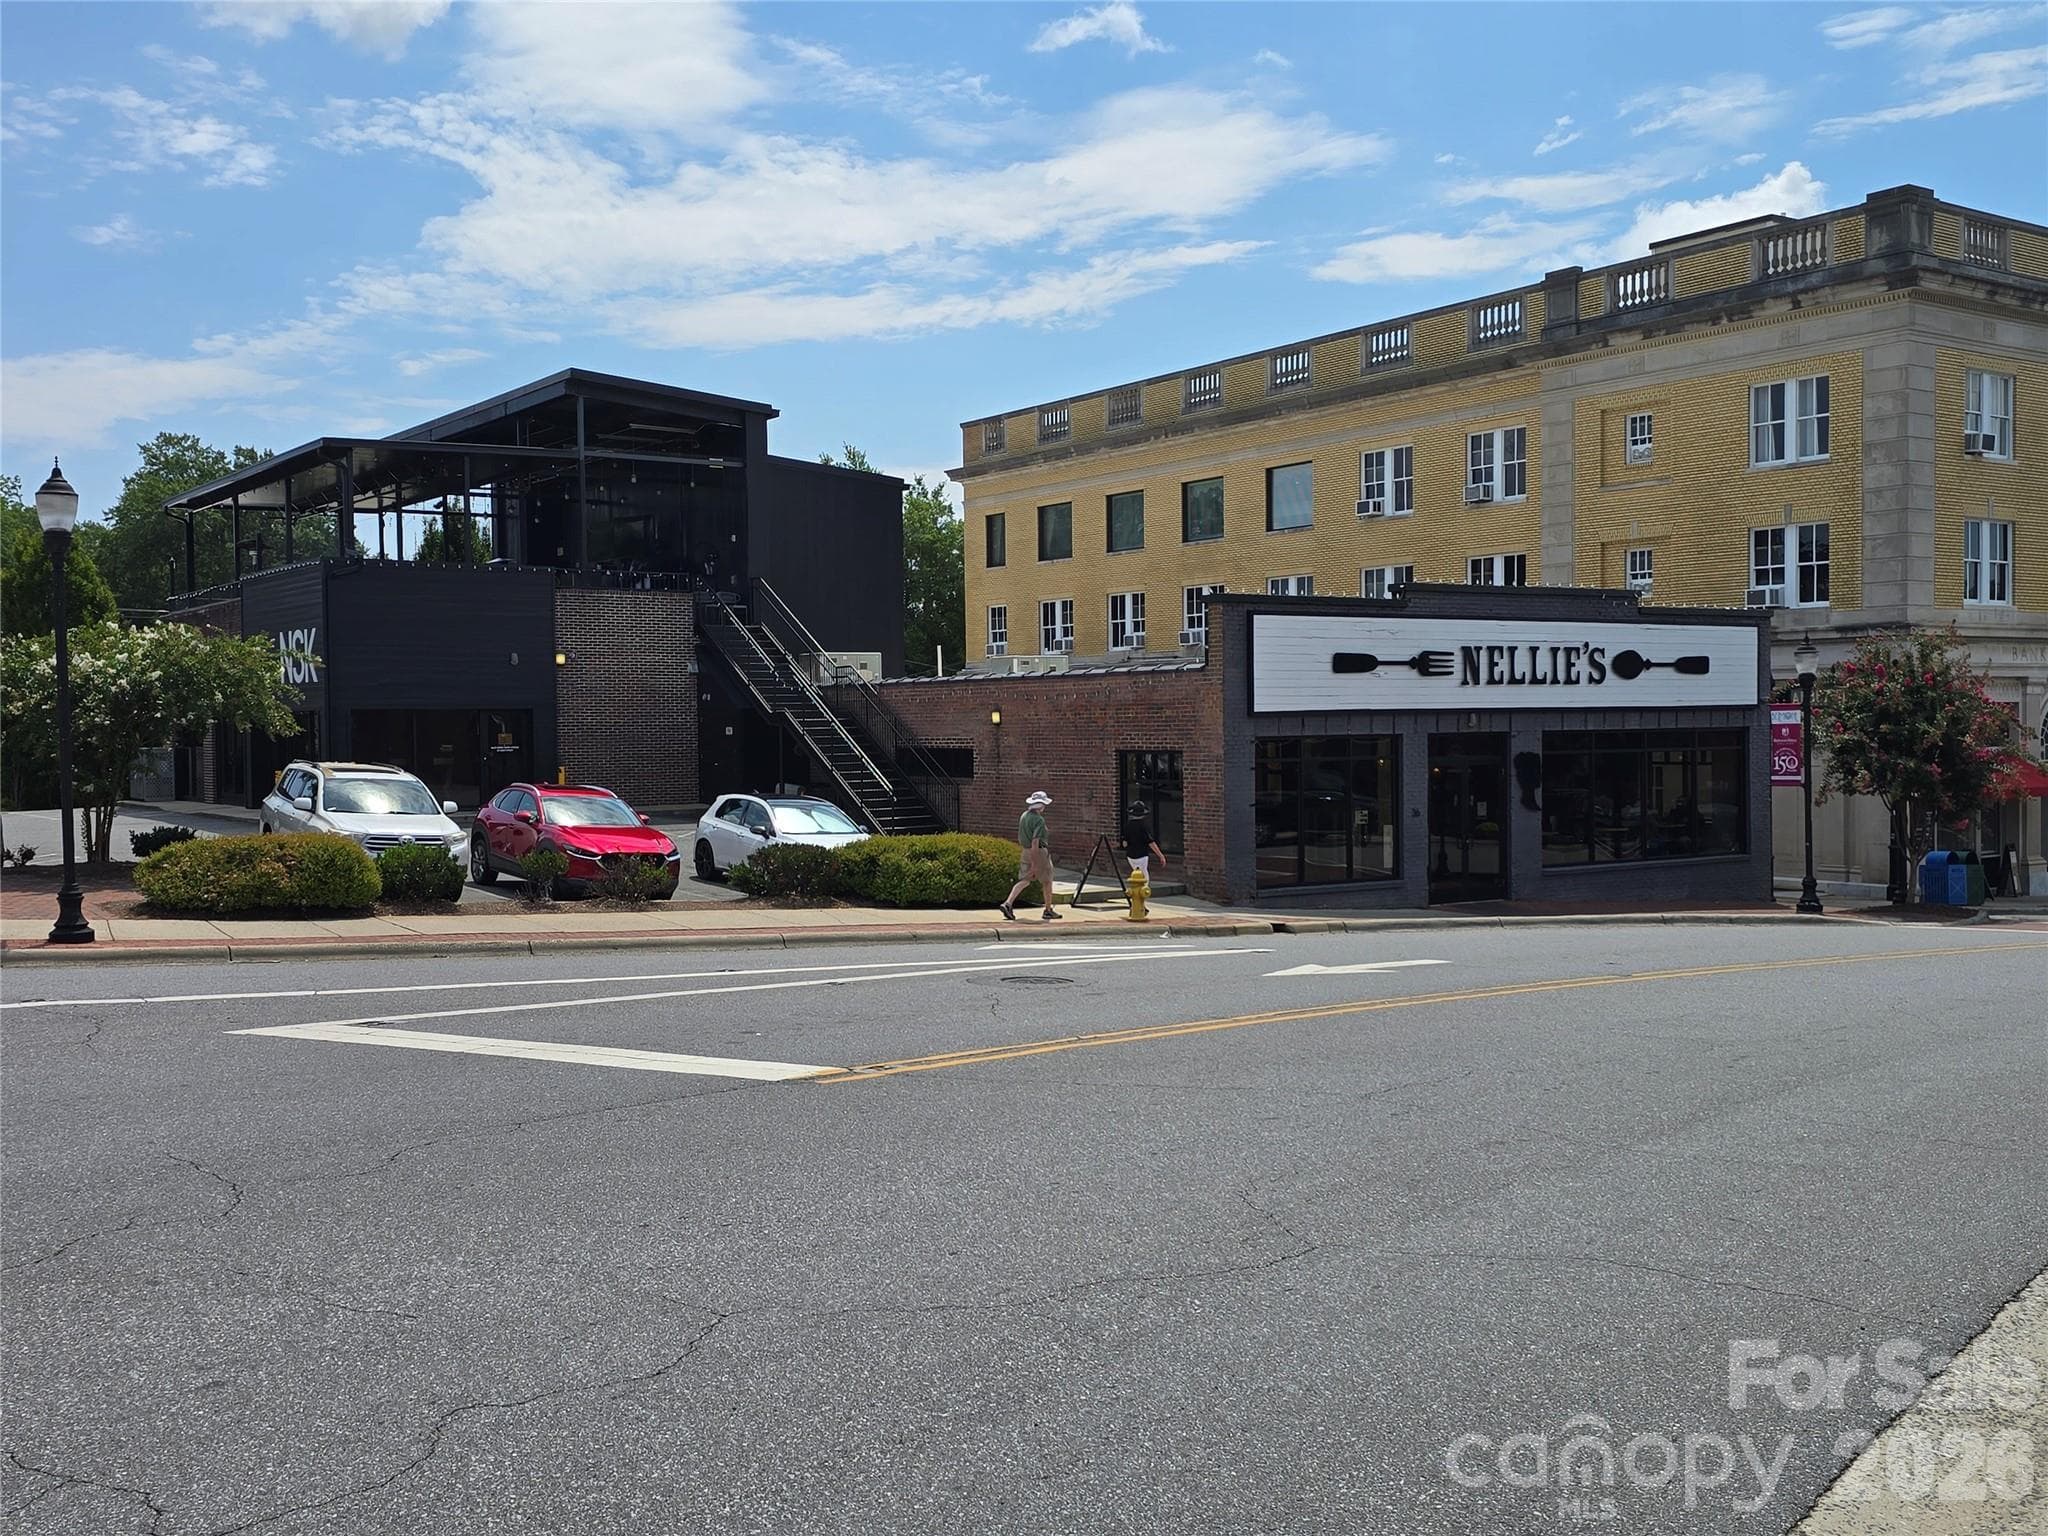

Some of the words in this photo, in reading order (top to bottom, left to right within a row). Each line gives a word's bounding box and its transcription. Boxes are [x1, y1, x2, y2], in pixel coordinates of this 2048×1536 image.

[280, 628, 318, 684] NSK
[1460, 641, 1607, 685] NELLIE'S
[1773, 755, 1799, 775] 150
